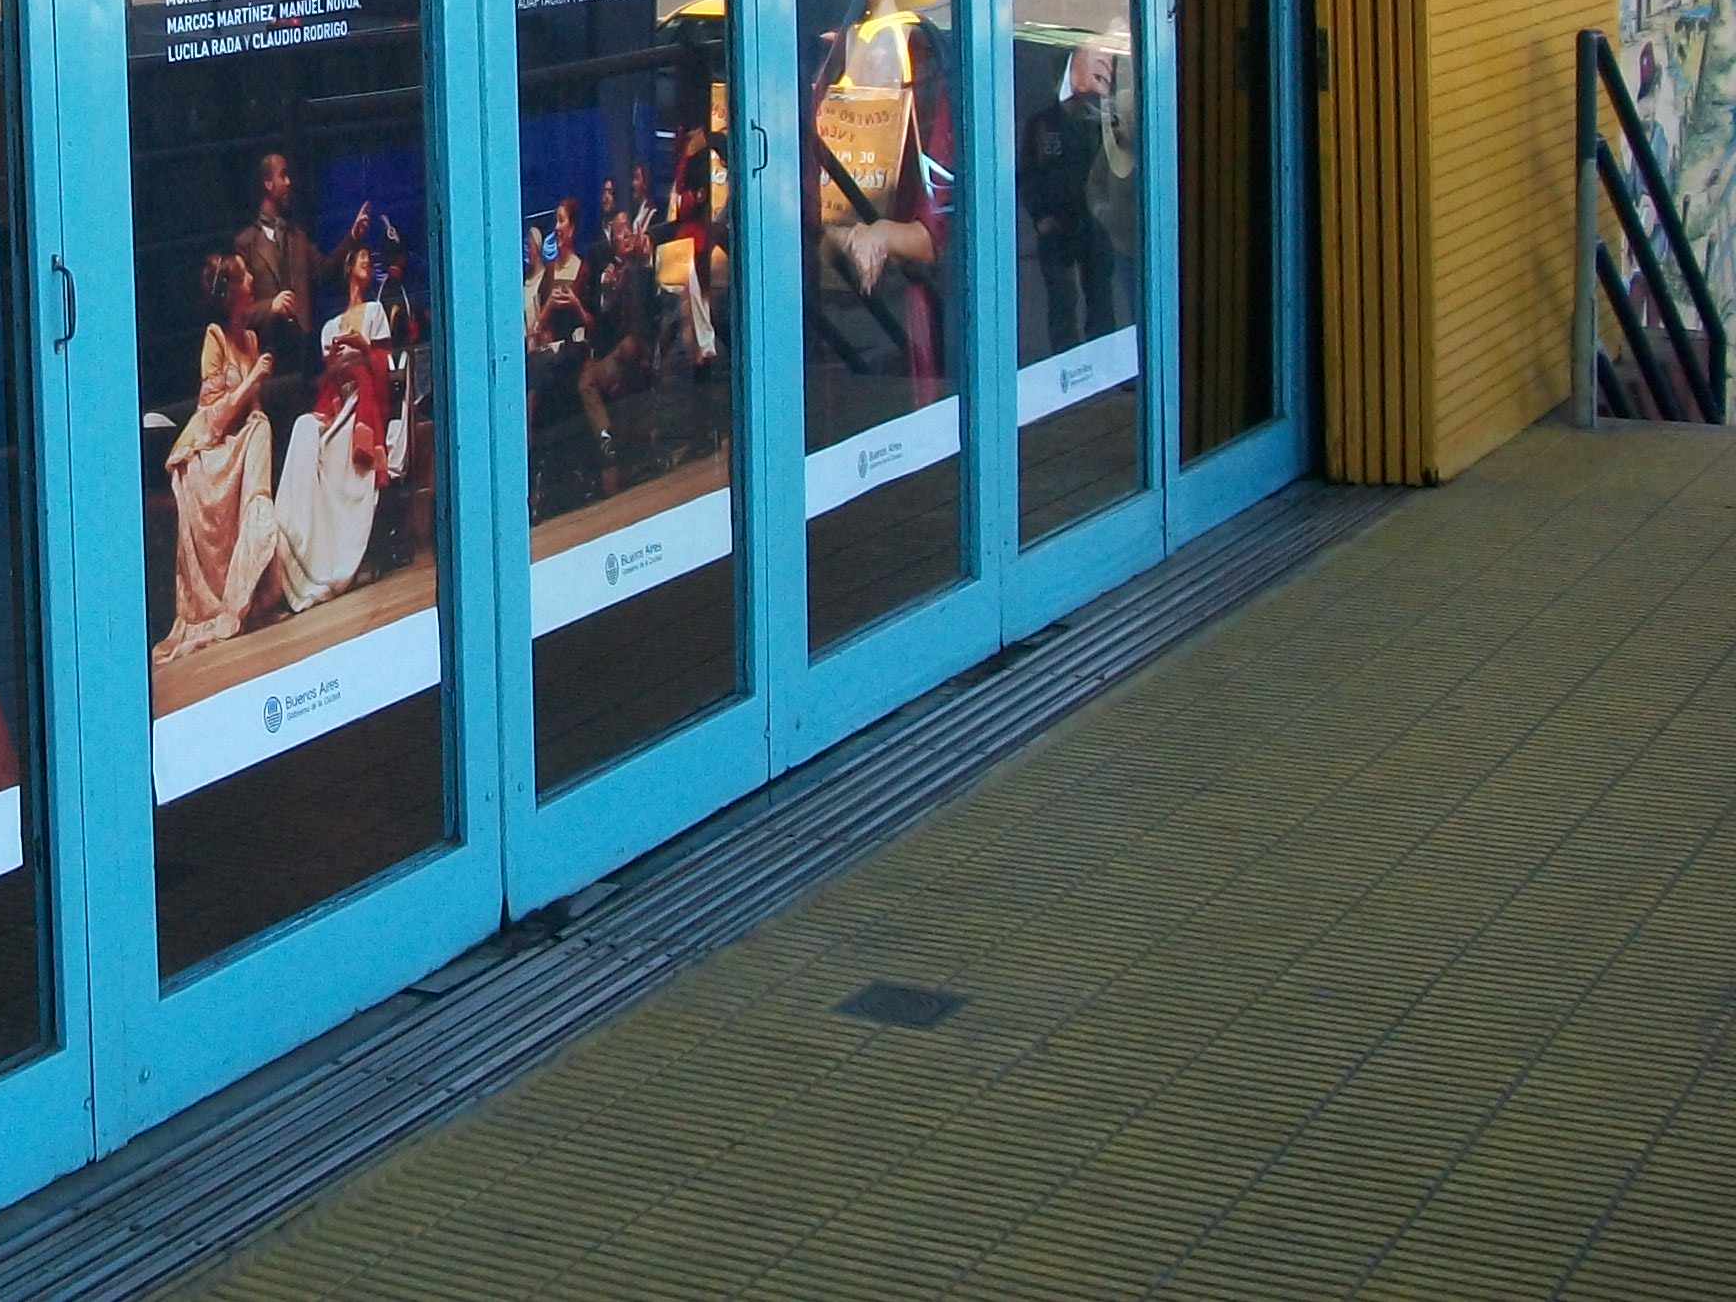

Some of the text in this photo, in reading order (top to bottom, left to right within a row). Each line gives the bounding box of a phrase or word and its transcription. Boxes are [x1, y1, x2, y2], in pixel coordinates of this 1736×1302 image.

[167, 12, 215, 35] MARCOS
[167, 40, 210, 63] LUCILA
[211, 36, 243, 56] RADA
[243, 34, 251, 51] Y
[252, 27, 302, 50] CLAUDIO
